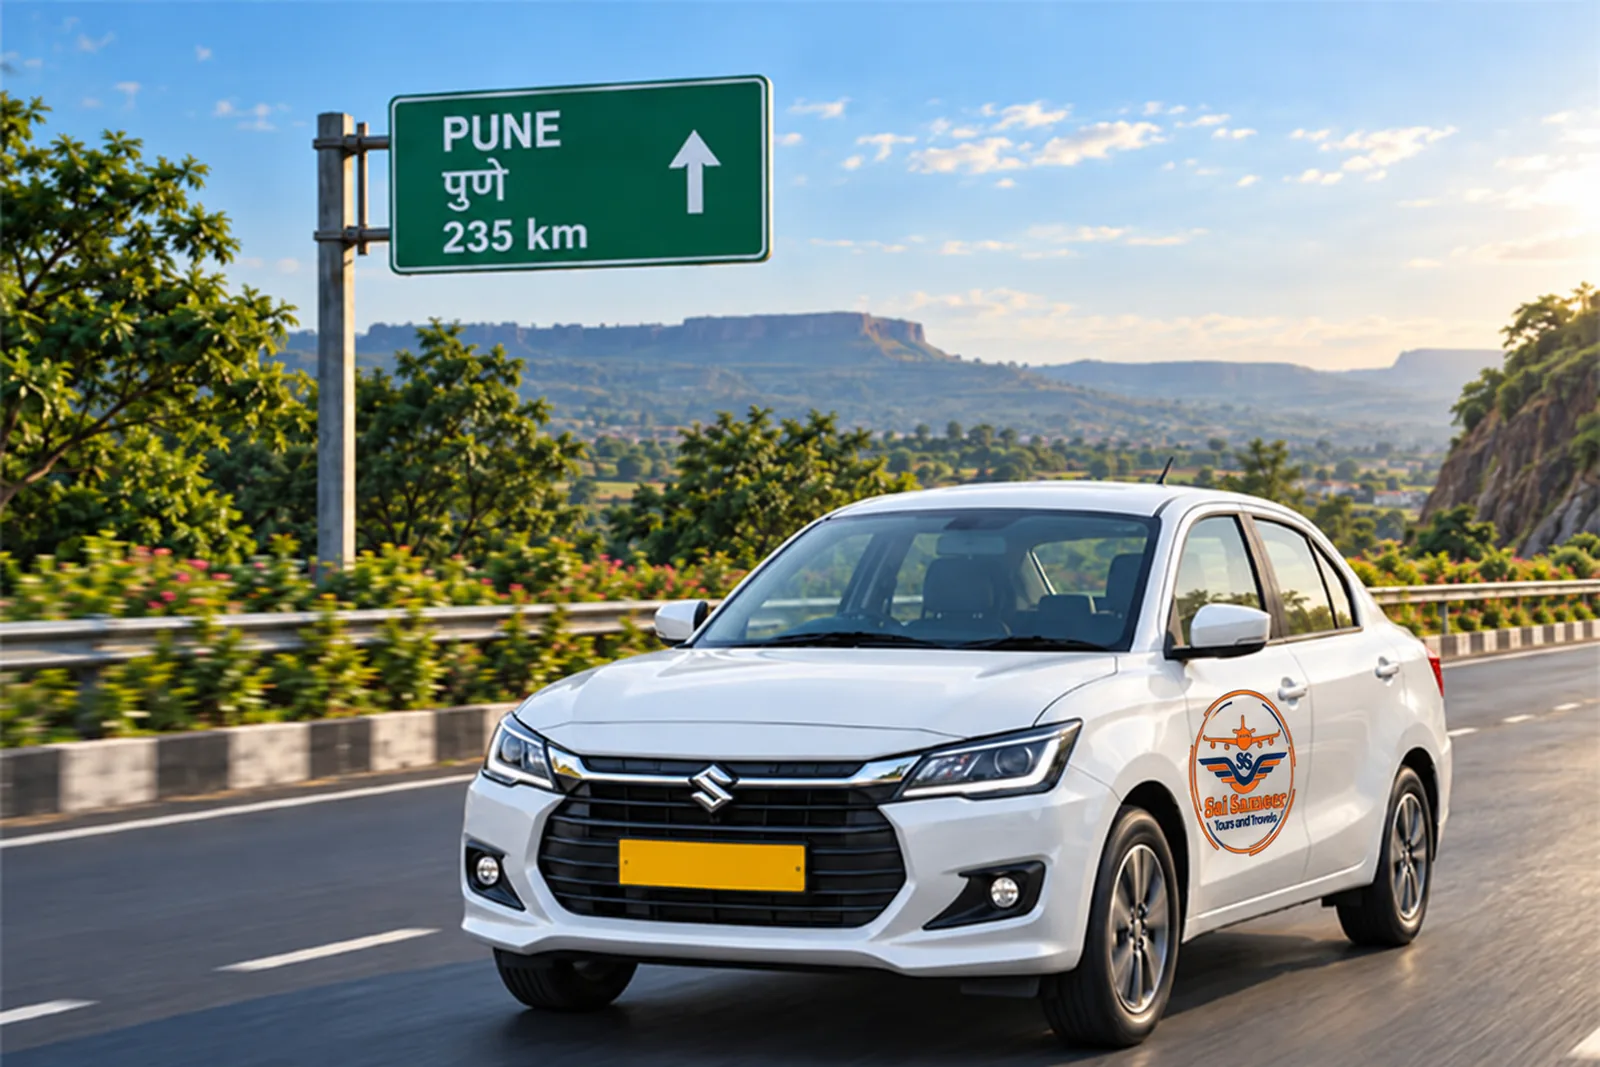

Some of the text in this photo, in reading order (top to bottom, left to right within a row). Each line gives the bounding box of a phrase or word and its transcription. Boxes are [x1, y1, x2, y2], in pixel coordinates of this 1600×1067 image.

[443, 110, 561, 152] PUNE
[442, 158, 509, 212] पुणे
[443, 218, 588, 253] 235 km
[1204, 795, 1228, 819] Sai
[1214, 818, 1234, 831] Tours
[1235, 815, 1250, 828] and
